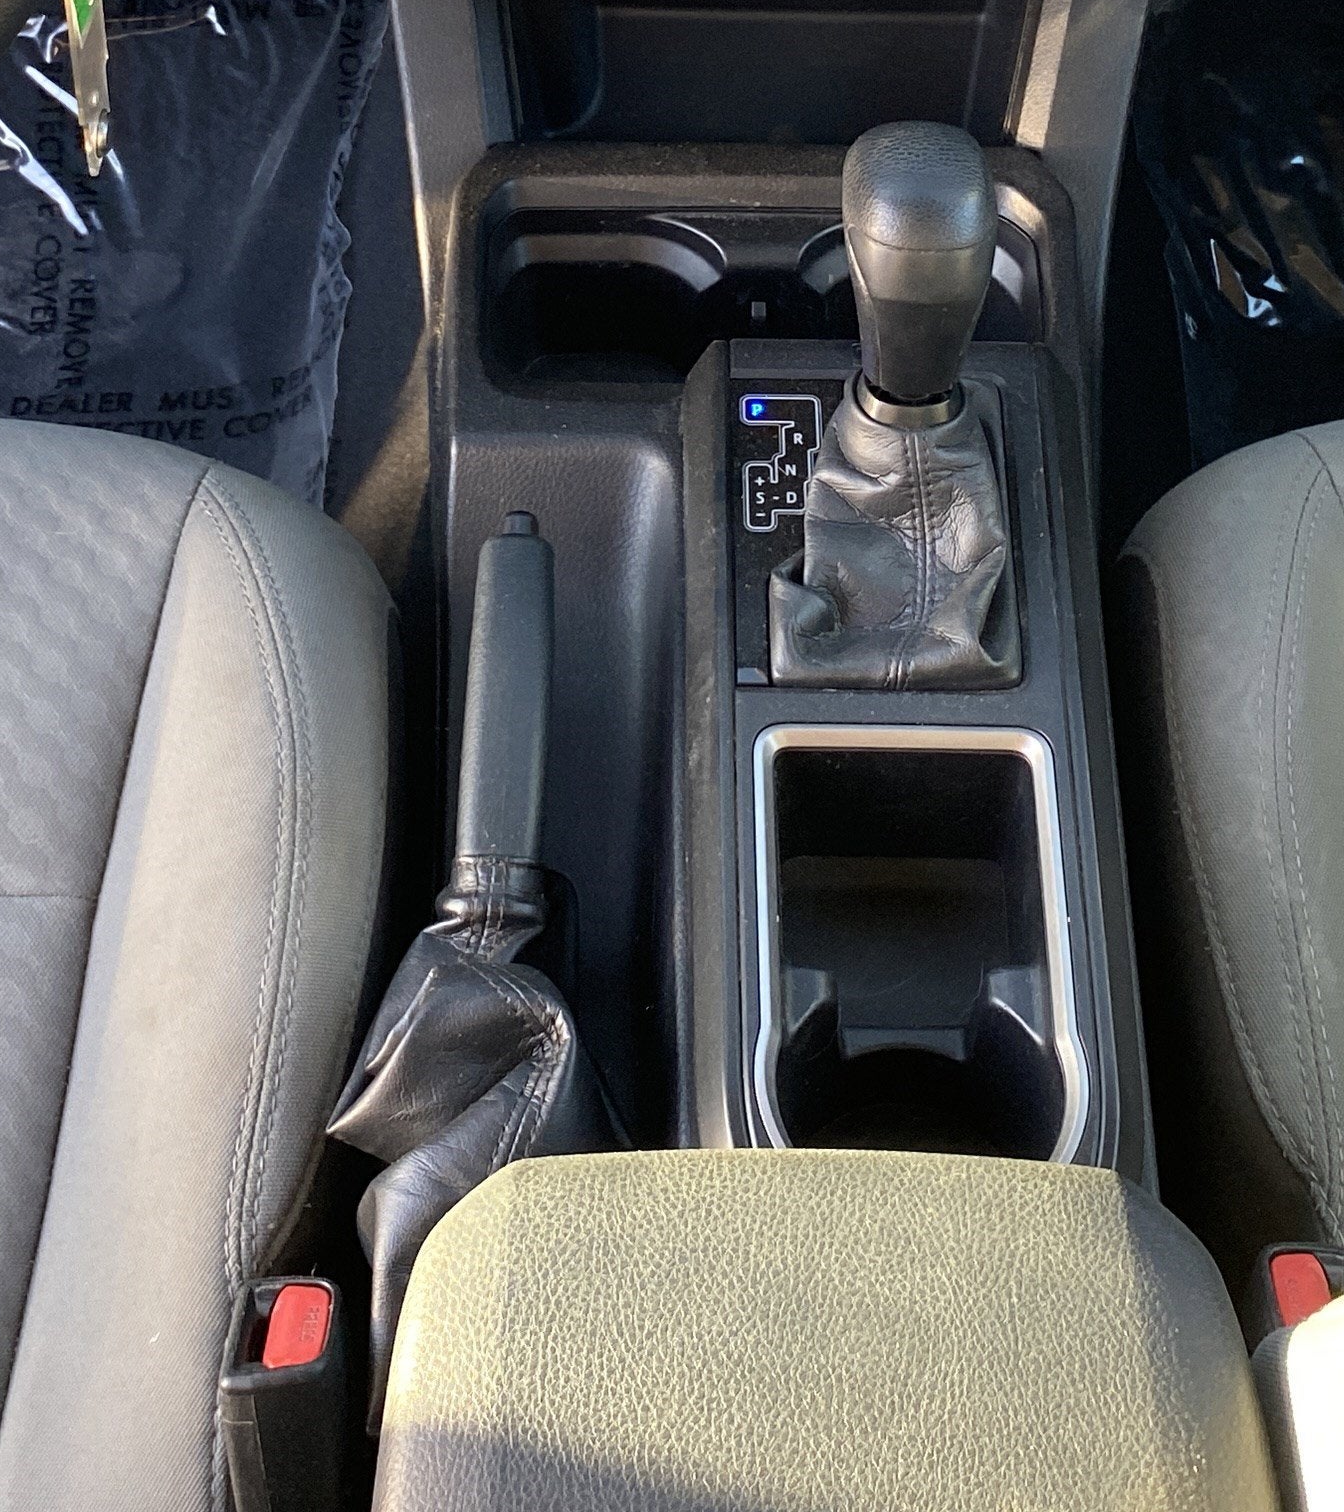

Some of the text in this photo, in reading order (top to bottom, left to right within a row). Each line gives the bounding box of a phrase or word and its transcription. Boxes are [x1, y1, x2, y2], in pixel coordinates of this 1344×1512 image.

[158, 385, 233, 412] MUS
[751, 402, 765, 416] P
[793, 432, 803, 445] R
[785, 464, 796, 476] N
[756, 491, 796, 504] S D
